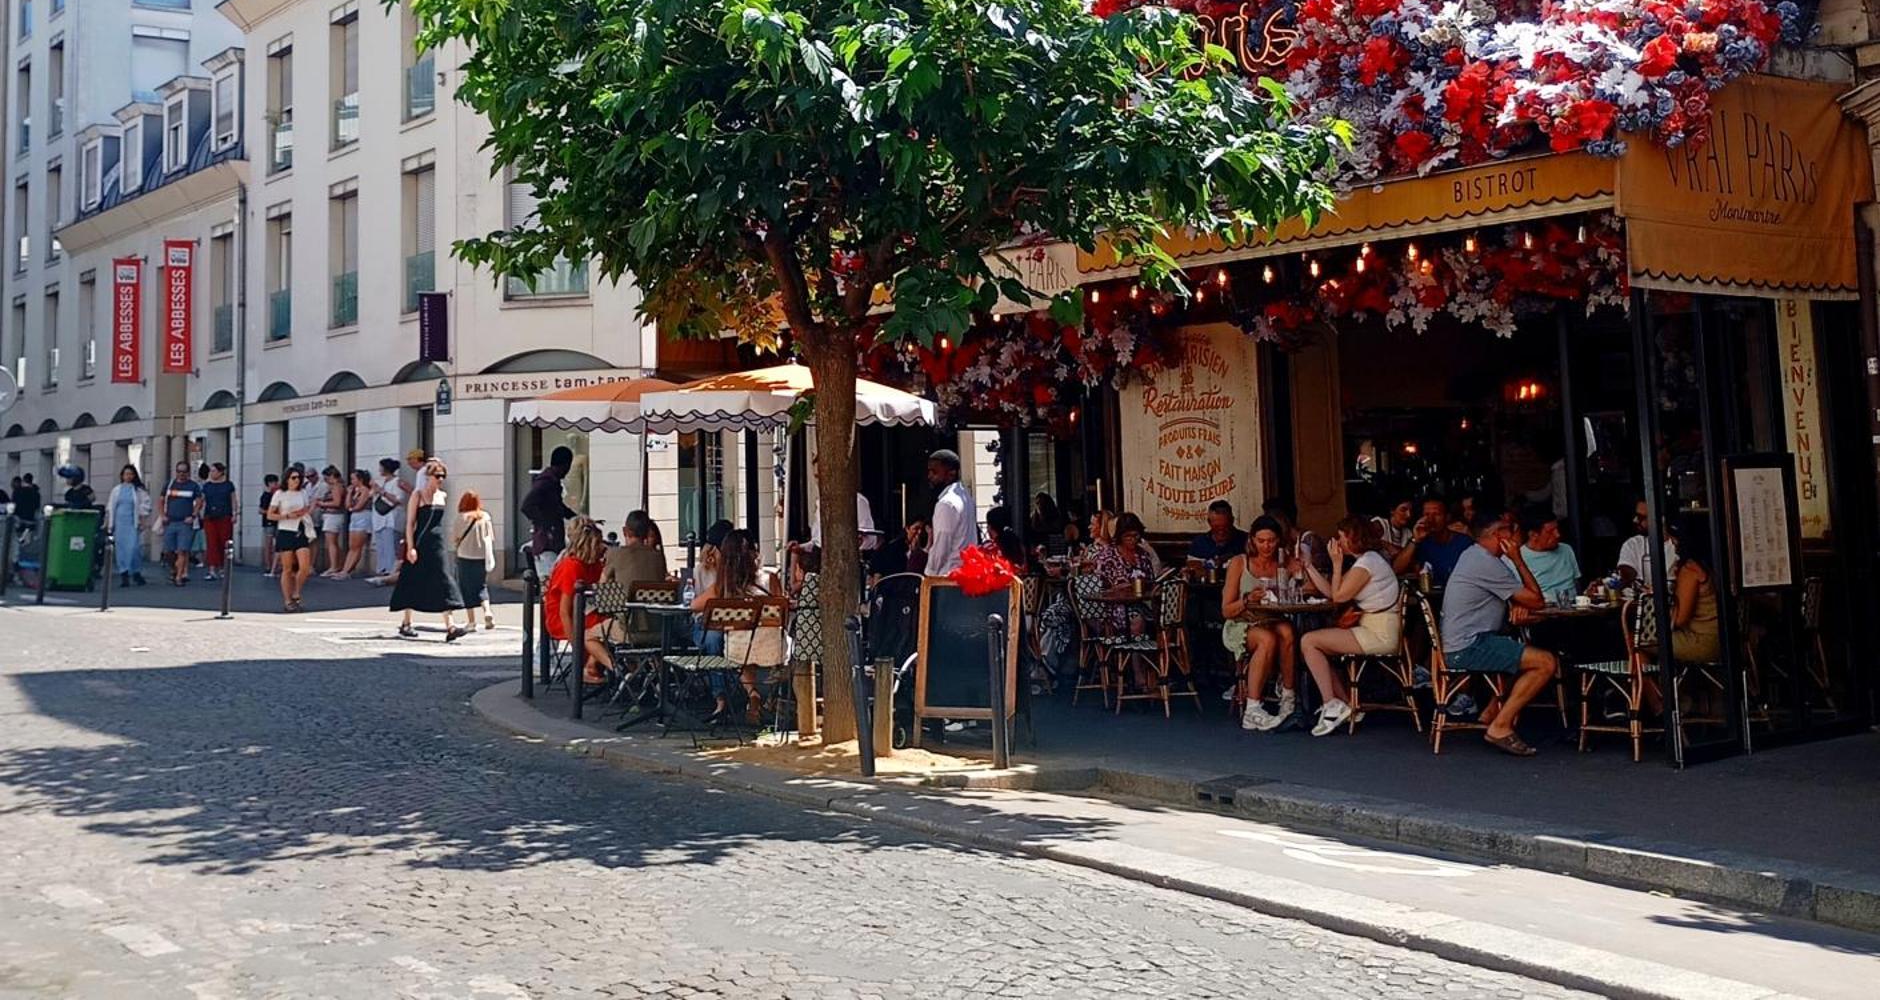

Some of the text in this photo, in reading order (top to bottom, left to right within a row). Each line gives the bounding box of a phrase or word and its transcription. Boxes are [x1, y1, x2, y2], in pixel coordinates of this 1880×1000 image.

[1743, 111, 1819, 206] PARIS
[1453, 167, 1537, 203] BISTROT
[1708, 199, 1782, 226] Montmartre
[1027, 249, 1068, 291] PARIS
[119, 285, 134, 351] ABBESSES
[170, 268, 186, 340] ABBESSES
[118, 354, 133, 378] LES
[170, 343, 186, 367] LES
[465, 380, 549, 393] PRINCESSE
[1143, 384, 1234, 417] Restauration
[1160, 458, 1221, 481] FAIT MAISON
[1157, 482, 1196, 503] TOUTE
[1198, 474, 1236, 502] HEURE
